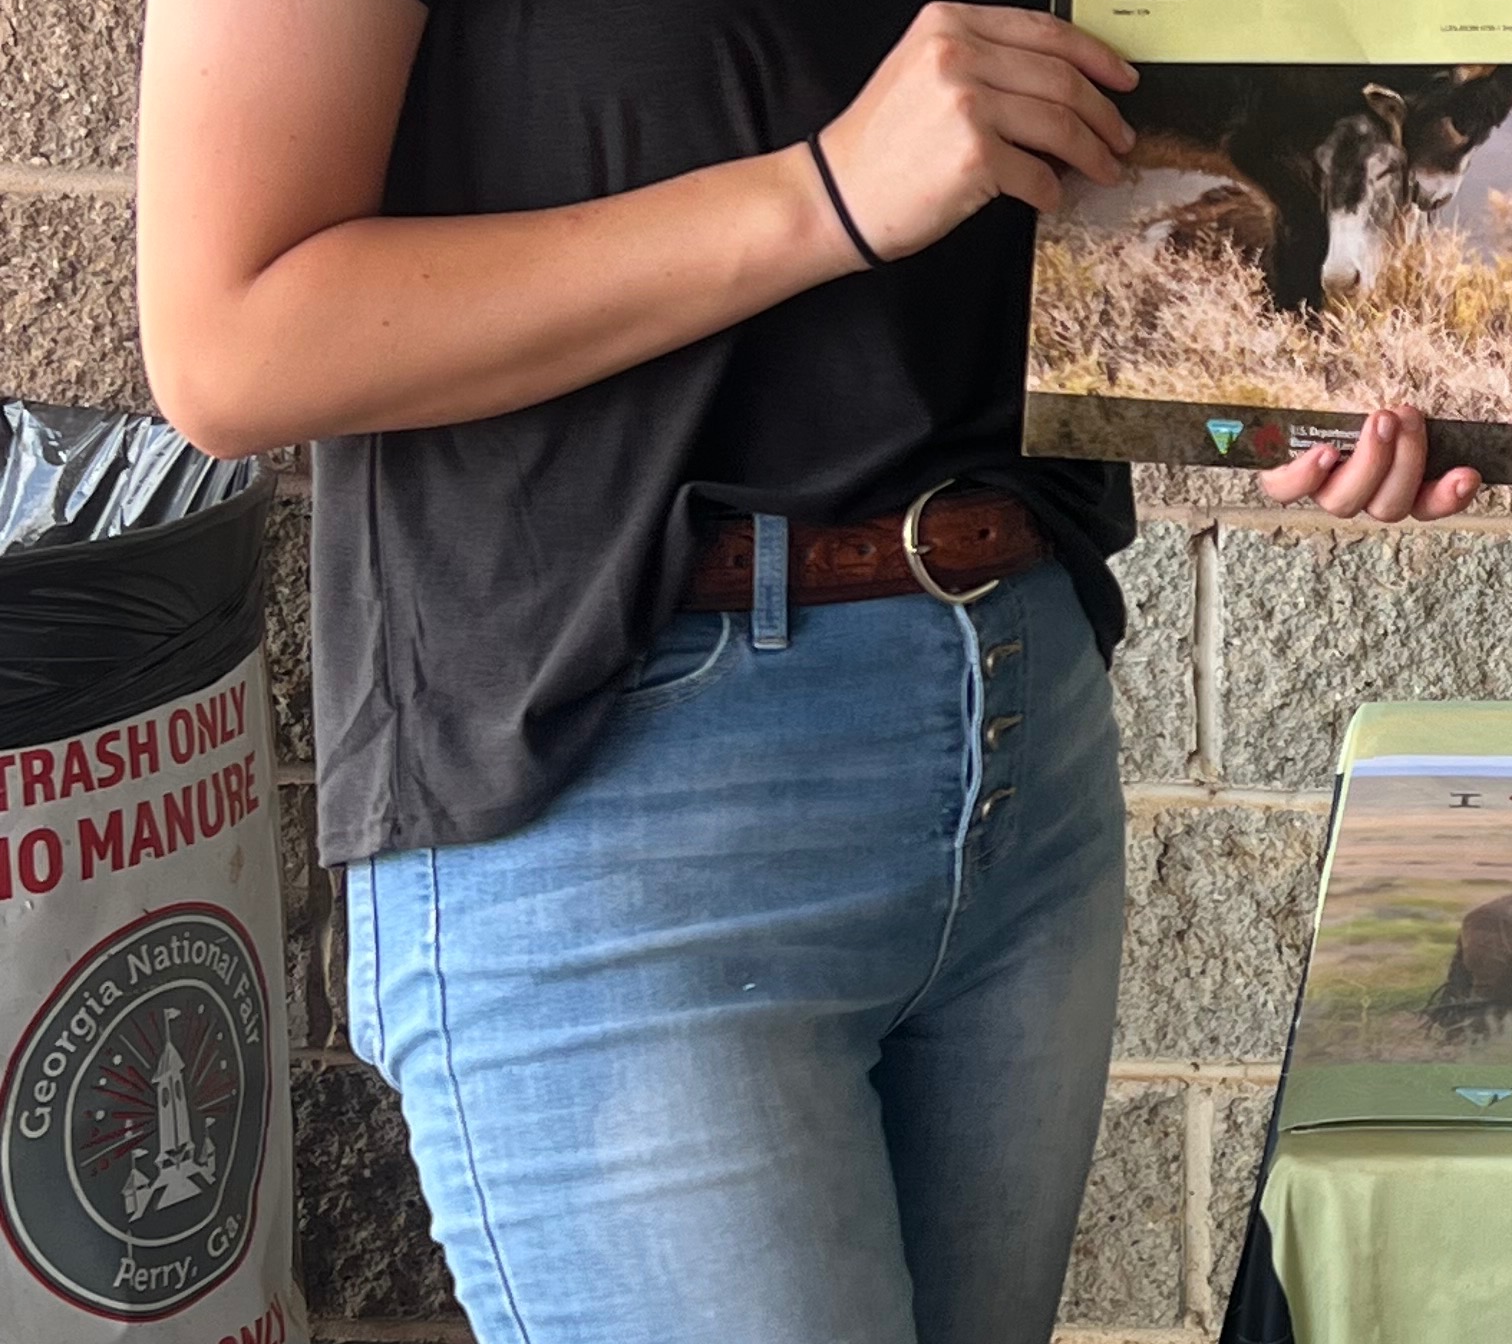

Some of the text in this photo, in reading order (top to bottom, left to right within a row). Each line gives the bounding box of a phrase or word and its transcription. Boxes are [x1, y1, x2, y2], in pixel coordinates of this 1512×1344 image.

[168, 680, 247, 766] ONLY
[77, 751, 259, 883] MANURE
[1450, 790, 1479, 809] I
[19, 931, 261, 1140] Georgia National Fair
[113, 1212, 243, 1292] Perry, Ga.
